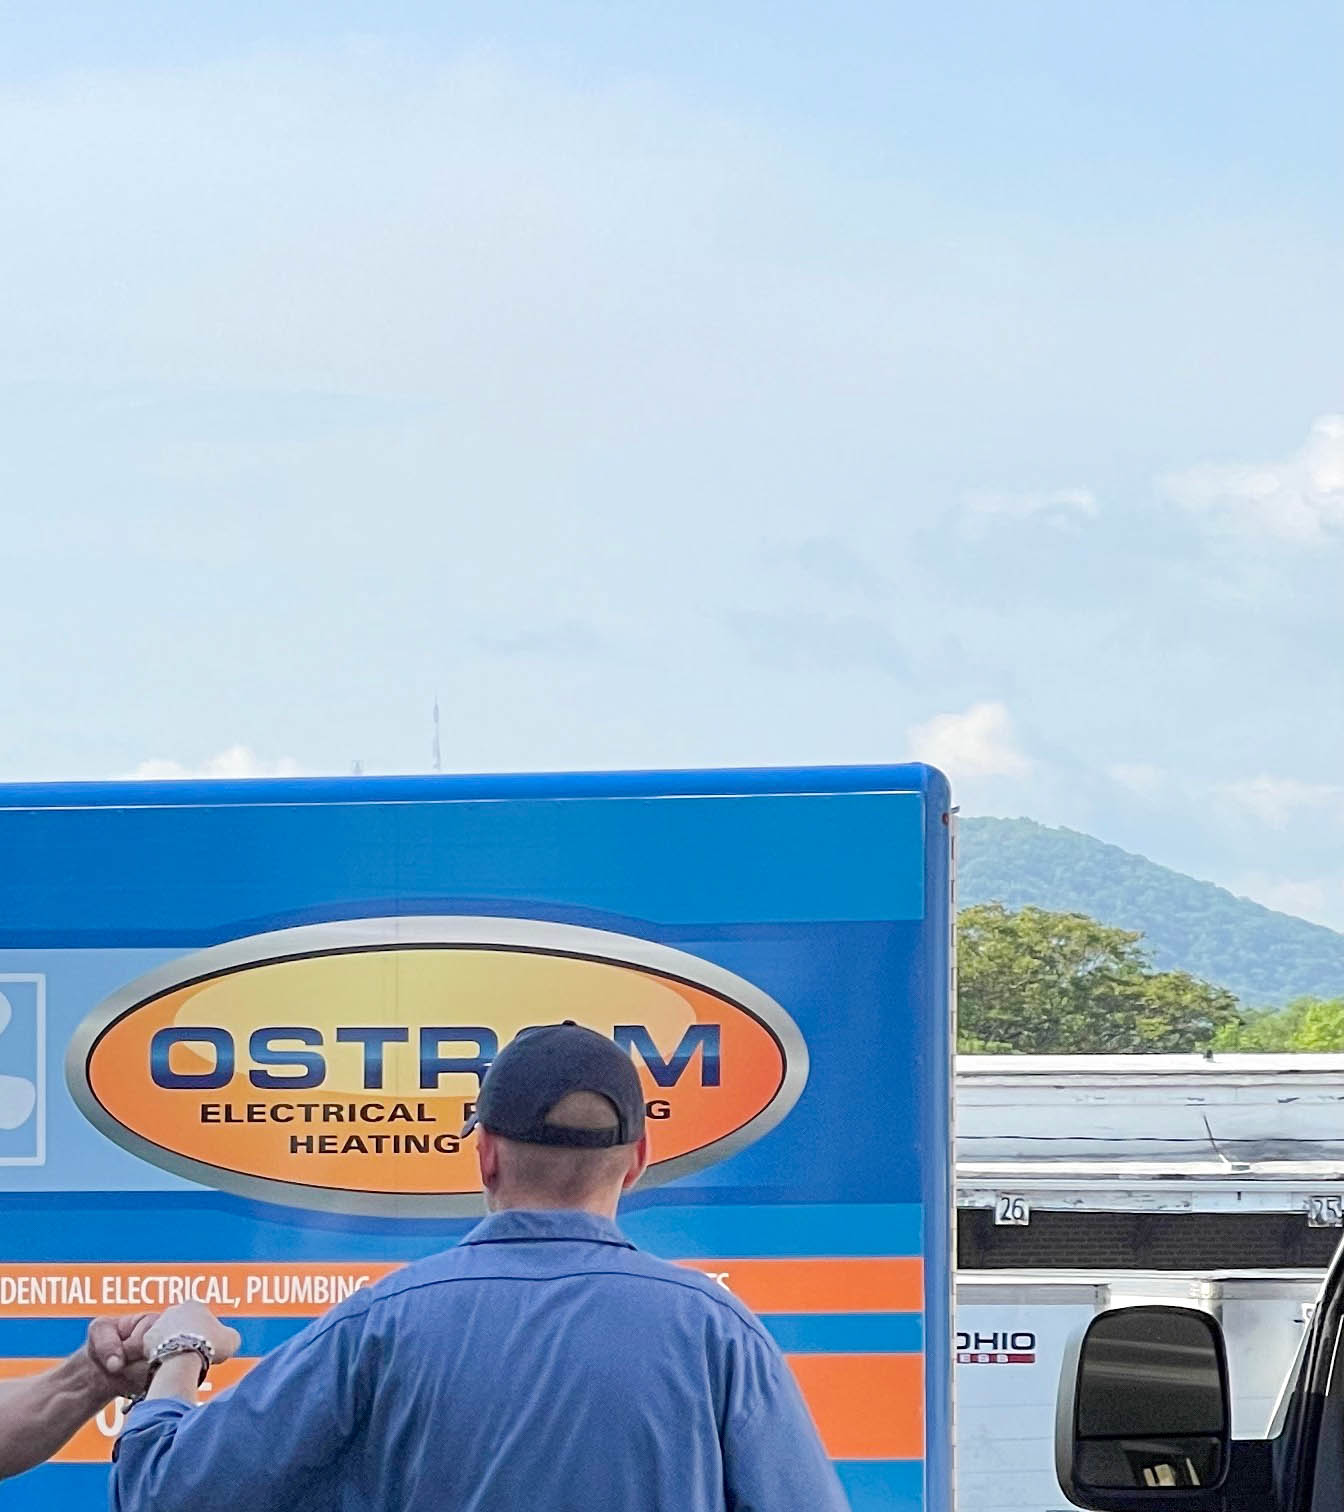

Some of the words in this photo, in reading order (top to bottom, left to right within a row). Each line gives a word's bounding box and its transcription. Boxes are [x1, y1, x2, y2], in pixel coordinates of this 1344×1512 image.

[150, 1025, 721, 1090] OSTRM
[200, 1103, 437, 1124] ELECTRICAL
[289, 1134, 461, 1154] HEATING
[1000, 1196, 1025, 1221] 26
[102, 1275, 241, 1308] ELECTRICAL,
